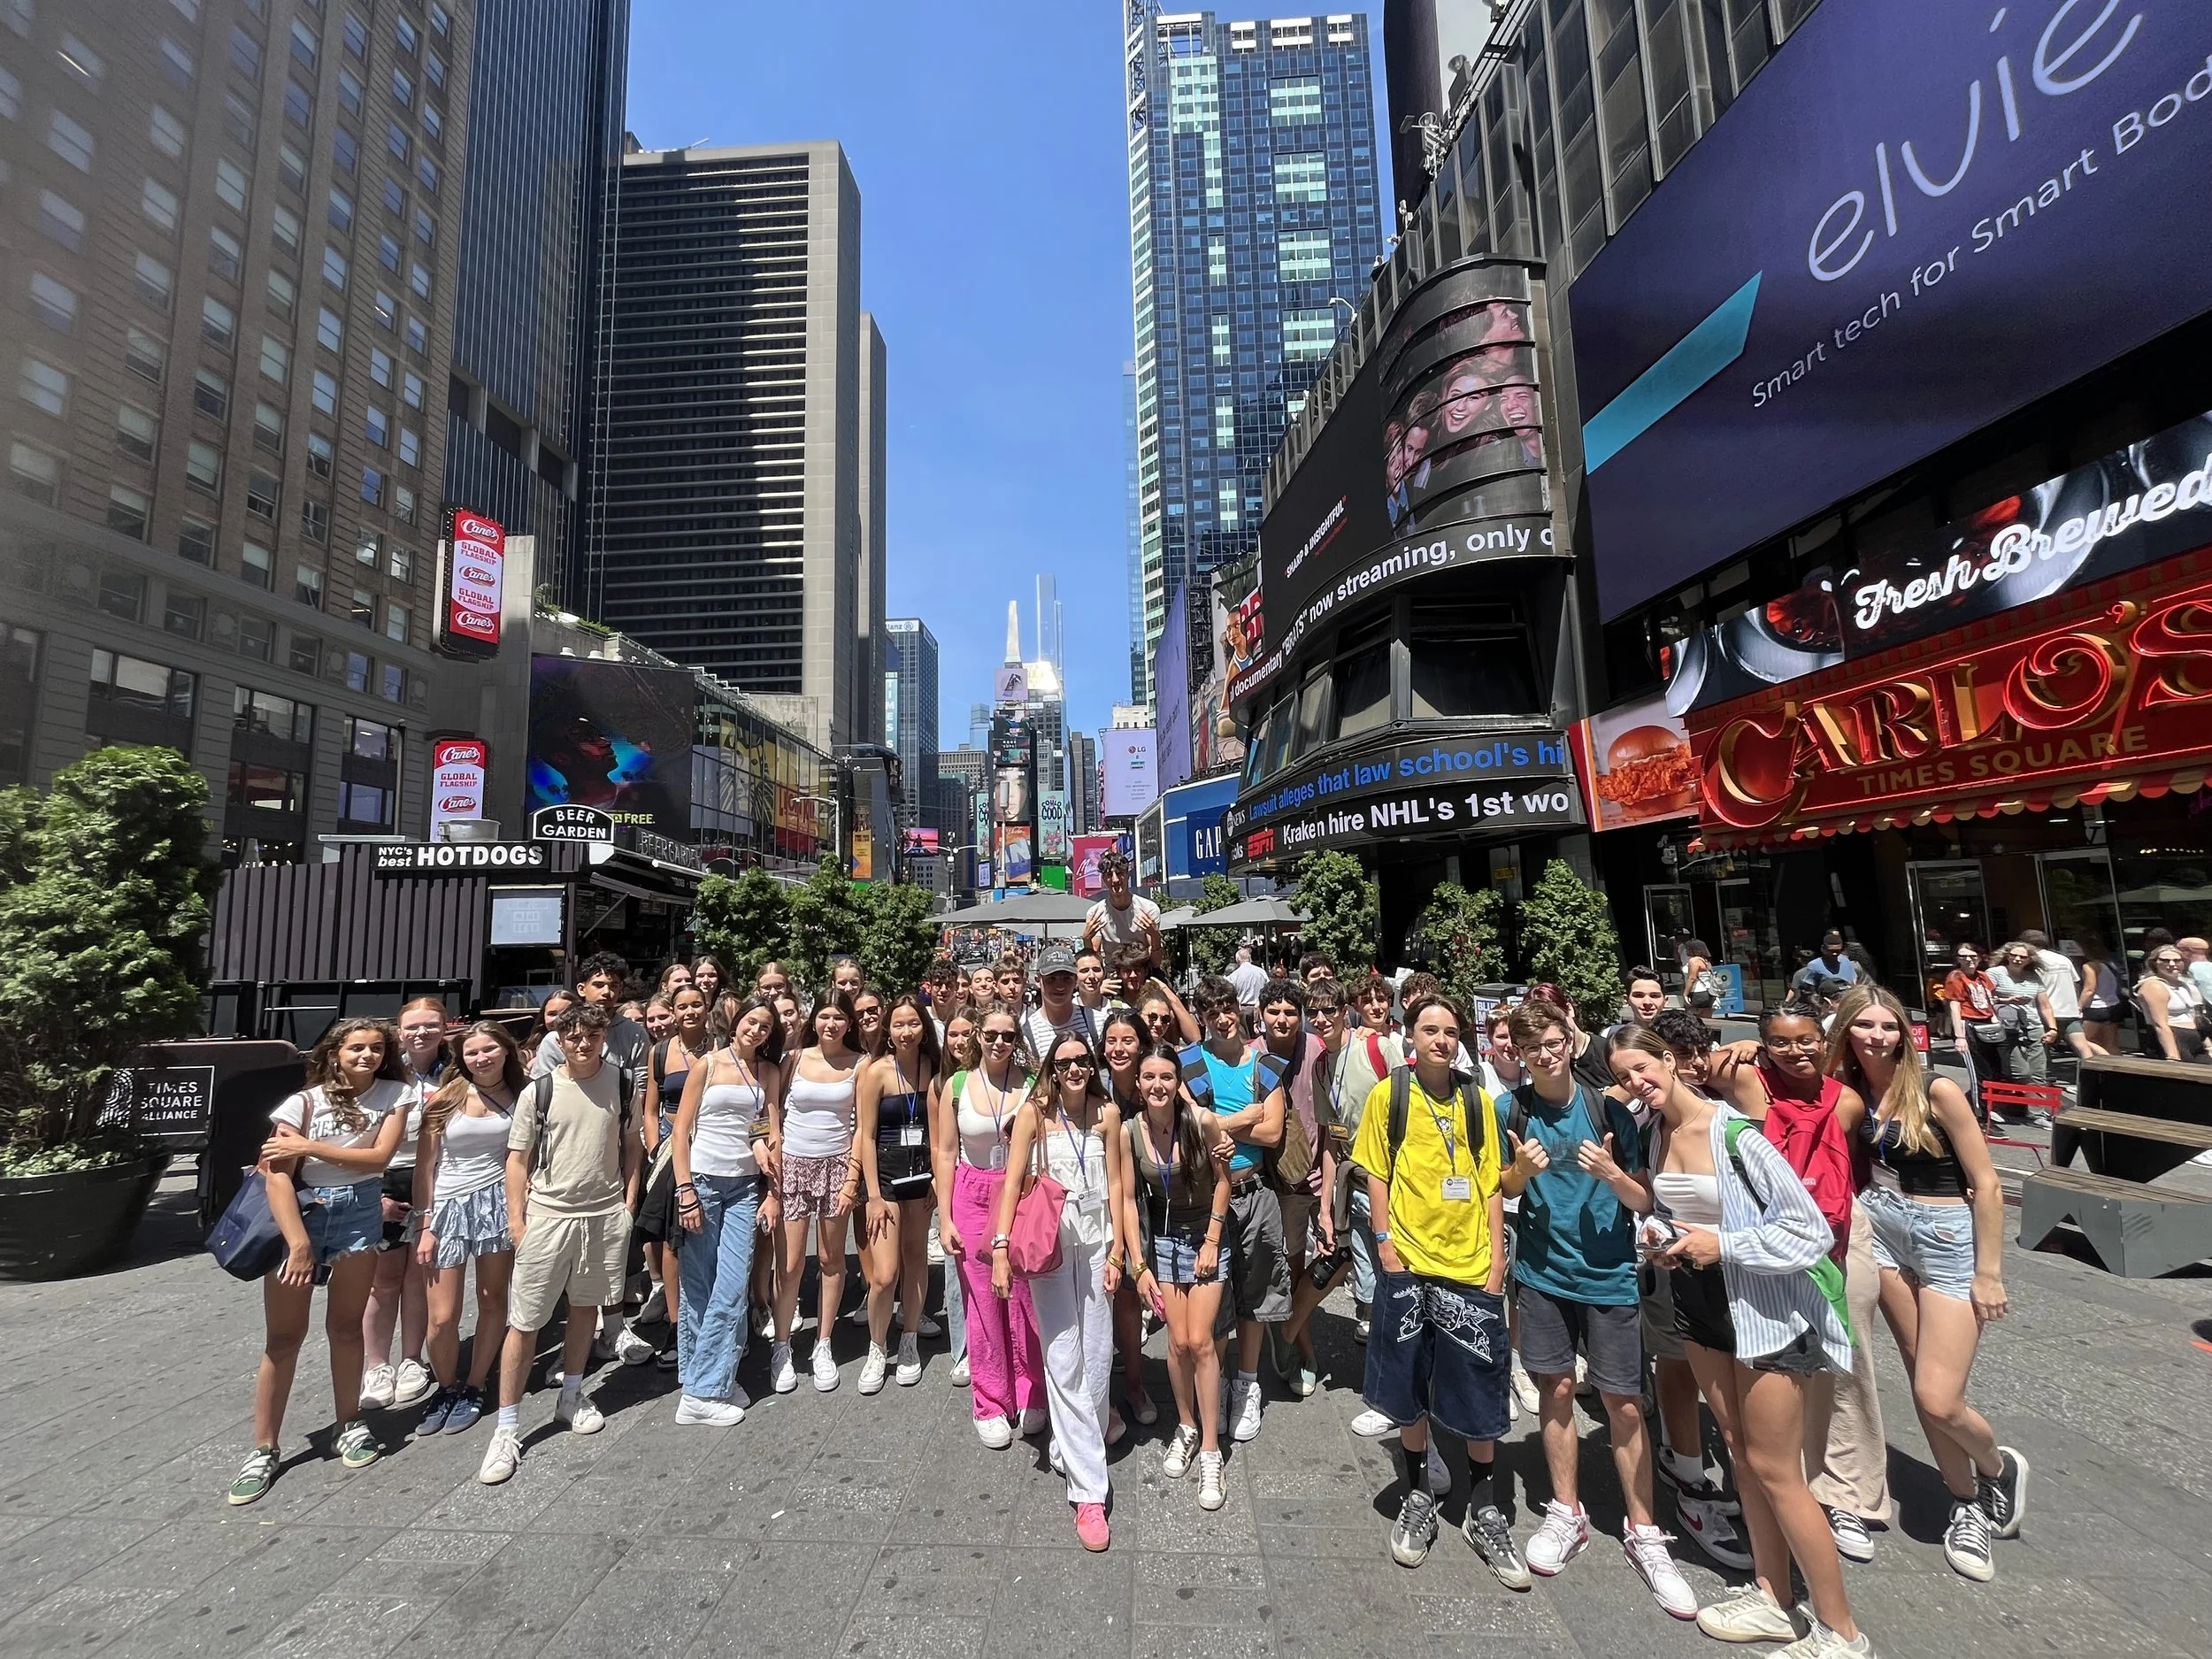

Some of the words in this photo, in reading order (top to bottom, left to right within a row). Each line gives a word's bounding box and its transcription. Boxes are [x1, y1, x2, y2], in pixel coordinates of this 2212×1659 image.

[1752, 342, 1827, 408] Smart
[1834, 288, 1901, 349] tech
[1910, 246, 1960, 296] for
[1970, 149, 2098, 255] Smart
[461, 518, 498, 538] Cane's
[1855, 553, 1985, 630] Fresh
[1982, 451, 2212, 581] Brewed
[460, 549, 496, 566] FLAGSHIP
[461, 541, 496, 559] GLOBAL
[459, 565, 495, 583] Cane's
[457, 595, 494, 611] FLAGSHIP
[458, 588, 494, 604] GLOBAL
[1234, 649, 1283, 697] documentary
[1309, 591, 1334, 623] now
[1337, 539, 1456, 603] streaming,
[1466, 523, 1531, 553] only
[456, 611, 493, 629] Cane's
[1702, 599, 2212, 827] CARLO'S
[440, 746, 480, 764] Cane's
[1856, 760, 1956, 795] TIMES
[1970, 725, 2150, 776] SQUARE
[1249, 794, 1278, 821] Lawsuit
[1279, 782, 1315, 807] alleges
[1317, 767, 1350, 795] that
[1354, 760, 1392, 787] law
[1399, 741, 1530, 777] school's
[439, 795, 476, 813] Cane's
[556, 809, 595, 825] BEER
[624, 812, 656, 824] FREE.
[1283, 820, 1325, 845] Kraken
[1328, 810, 1364, 835] hire
[1371, 798, 1455, 828] NHL's
[1465, 791, 1515, 818] 1st
[541, 825, 607, 839] GARDEN
[378, 847, 413, 856] NYC's
[1195, 826, 1222, 859] GAP
[378, 856, 412, 867] best
[417, 845, 543, 866] HOTDOGS
[1912, 1027, 1923, 1036] OF
[147, 1081, 198, 1094] TIMES
[141, 1095, 203, 1109] SQUARE
[142, 1110, 198, 1120] ALLIANCE
